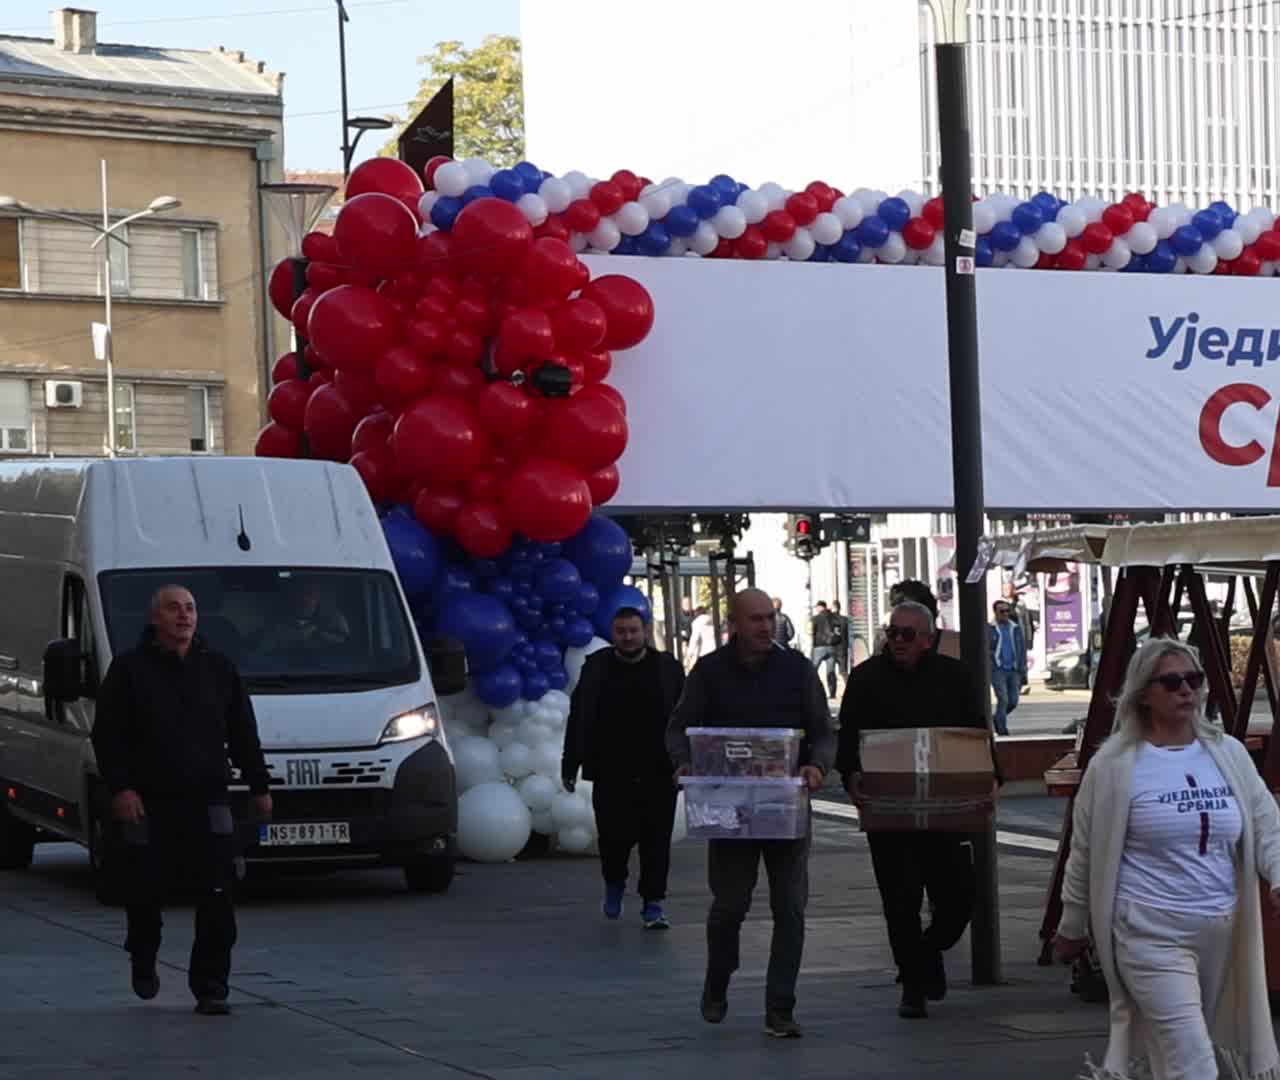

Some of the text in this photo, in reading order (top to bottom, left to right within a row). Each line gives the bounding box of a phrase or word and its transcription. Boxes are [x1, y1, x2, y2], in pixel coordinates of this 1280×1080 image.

[286, 759, 321, 785] FIAT
[1176, 798, 1229, 814] СРБИЈА
[269, 825, 289, 840] NS
